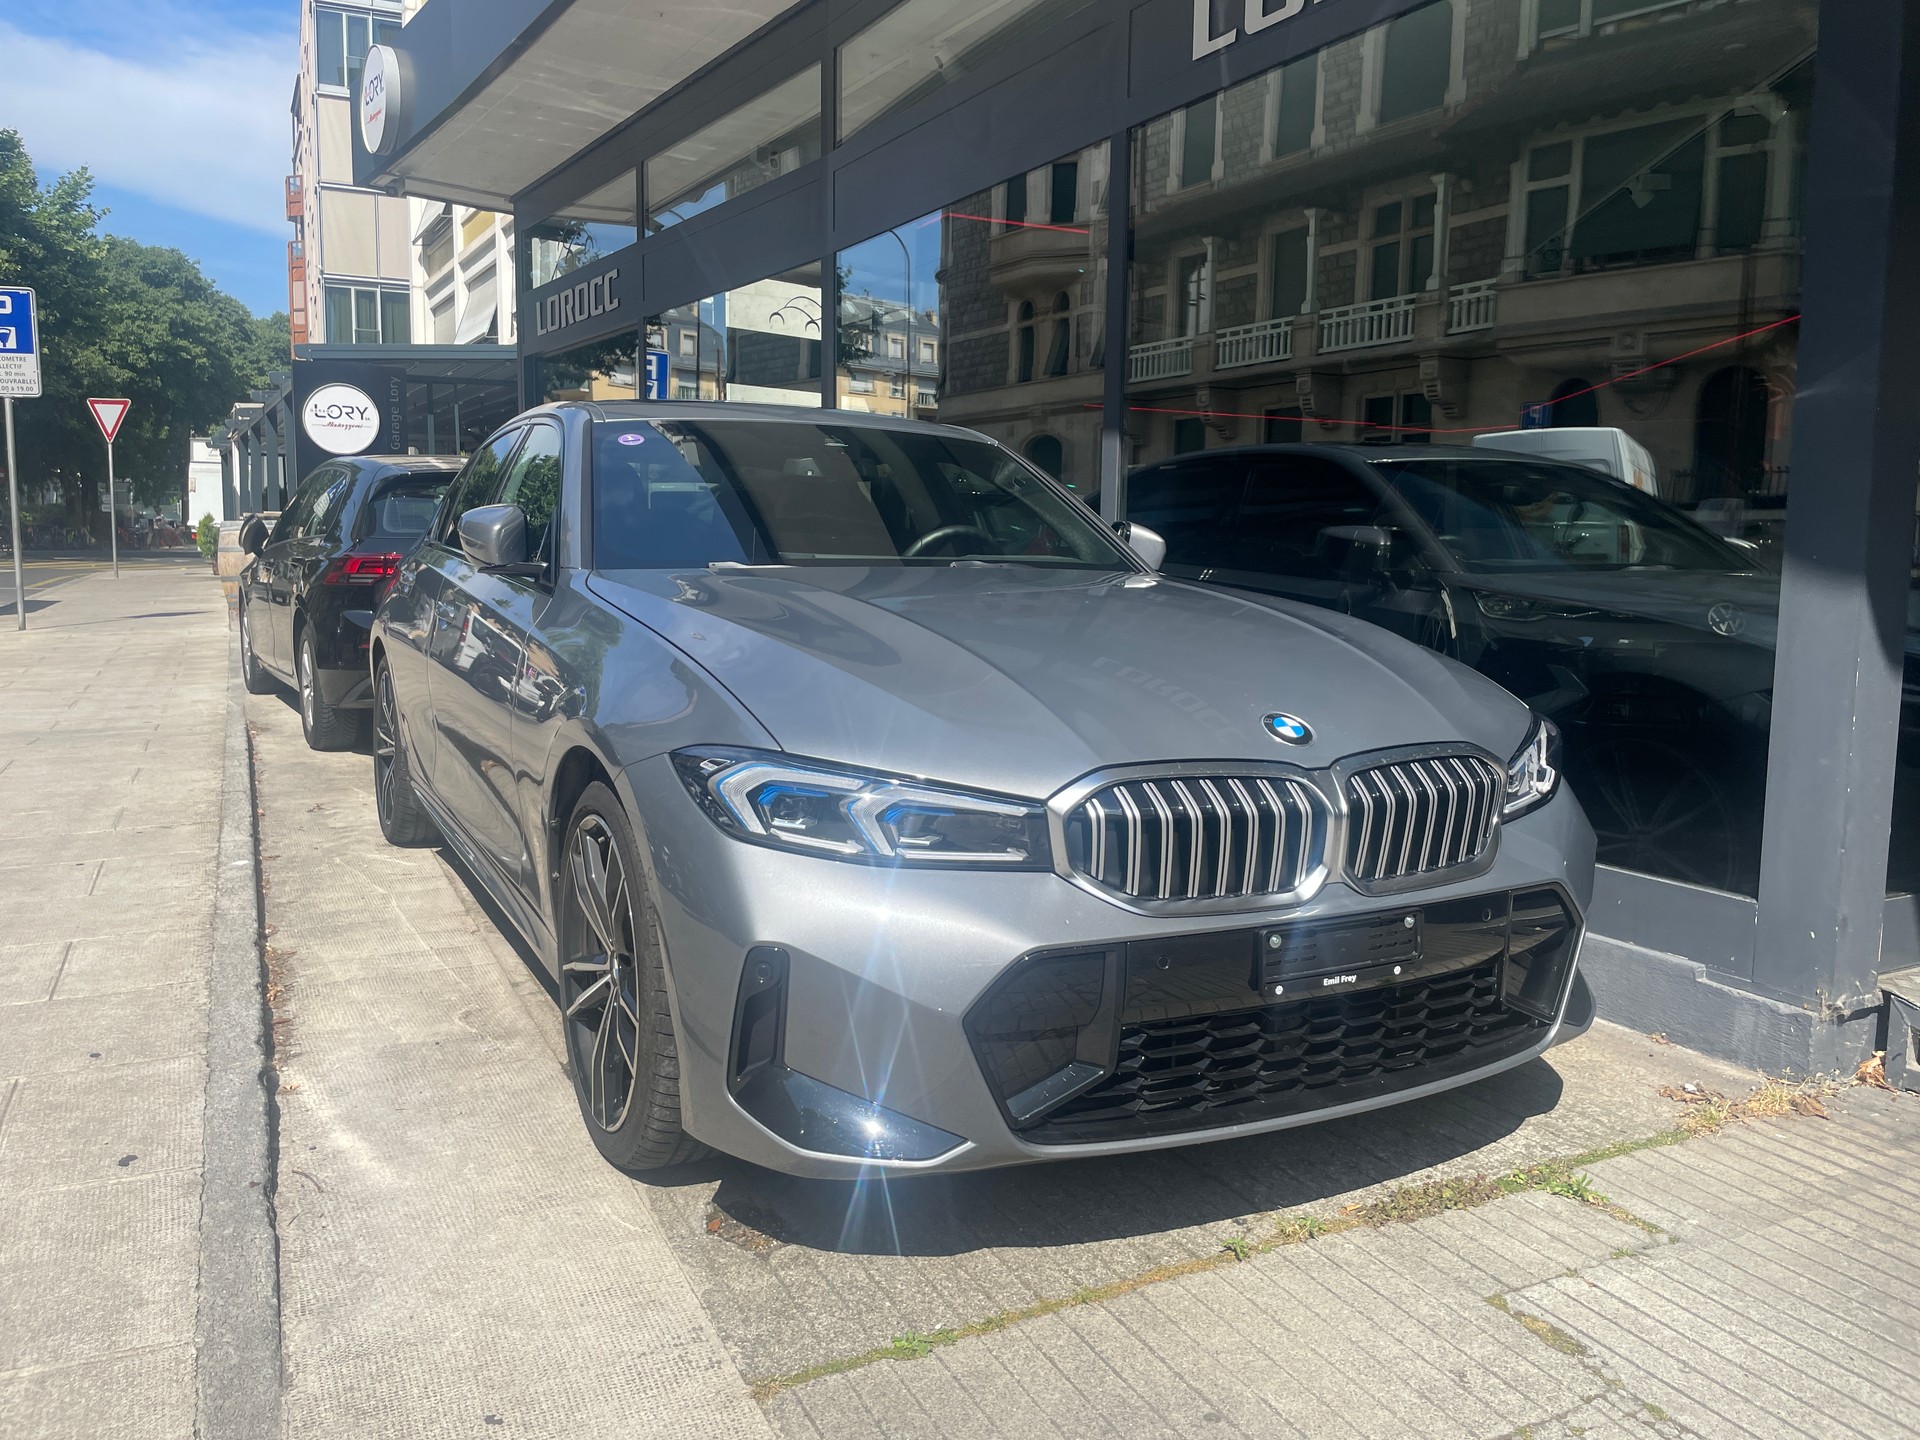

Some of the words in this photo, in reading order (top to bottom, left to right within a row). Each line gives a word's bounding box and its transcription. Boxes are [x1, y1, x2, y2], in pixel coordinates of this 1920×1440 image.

[536, 268, 619, 336] LOROCC
[390, 376, 400, 401] Lory
[314, 403, 368, 420] LORY
[391, 407, 402, 450] Garage
[1323, 976, 1340, 986] Emil
[1341, 975, 1357, 983] Frey
